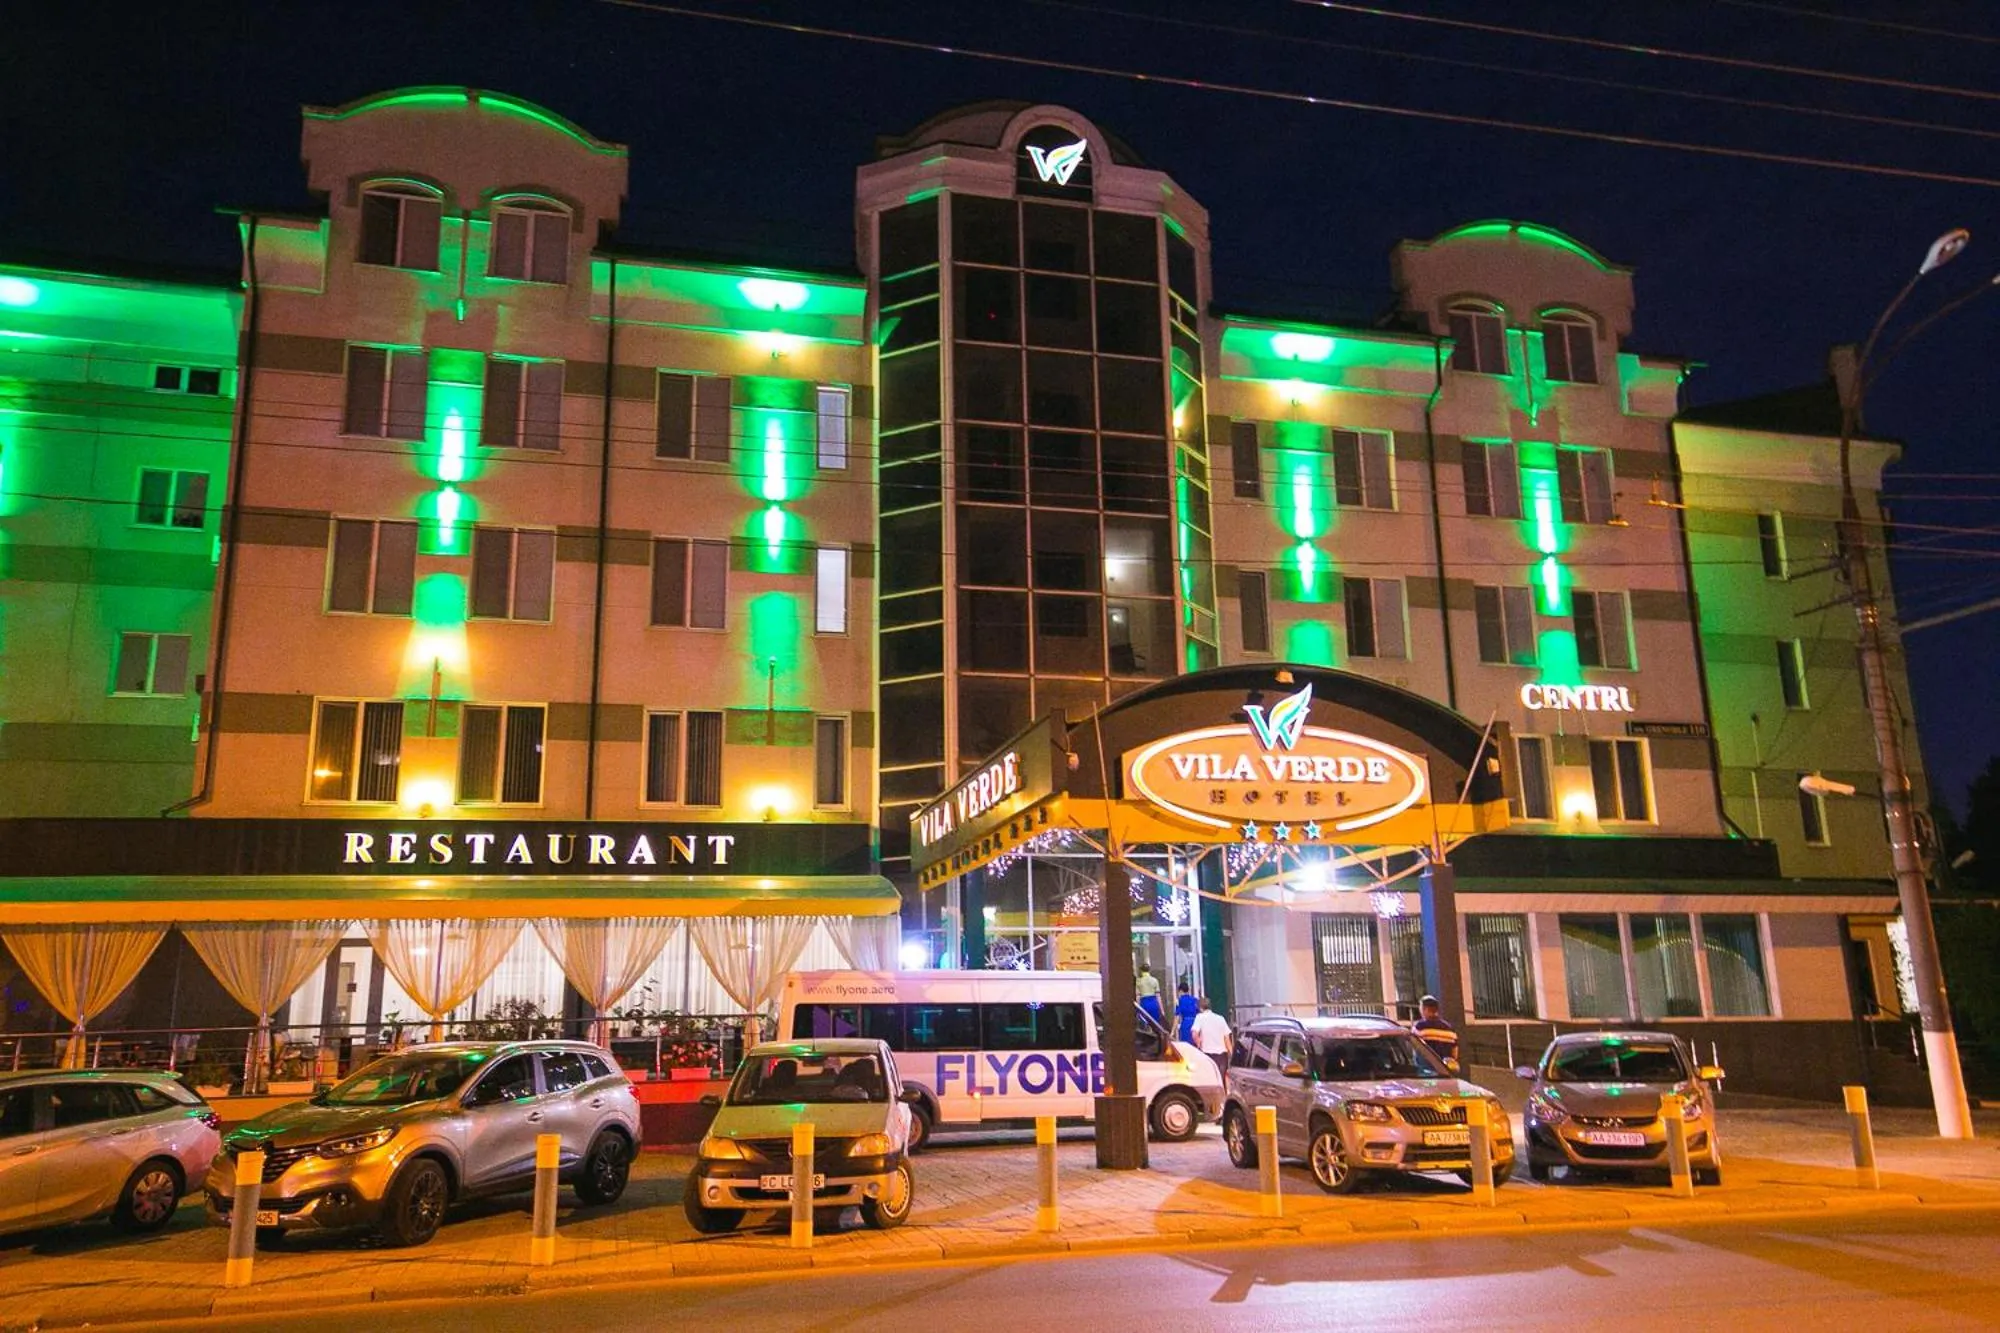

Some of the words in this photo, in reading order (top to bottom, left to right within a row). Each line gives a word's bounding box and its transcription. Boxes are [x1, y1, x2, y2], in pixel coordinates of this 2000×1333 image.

[1169, 753, 1258, 782] VILA
[1260, 755, 1391, 784] VERDE
[919, 801, 953, 847] VILA
[957, 752, 1019, 823] VERDE
[1209, 789, 1352, 806] HOTEL
[343, 832, 734, 865] RESTAURANT
[807, 984, 895, 996] www.flyone.aero
[936, 1053, 1105, 1097] FLYONE
